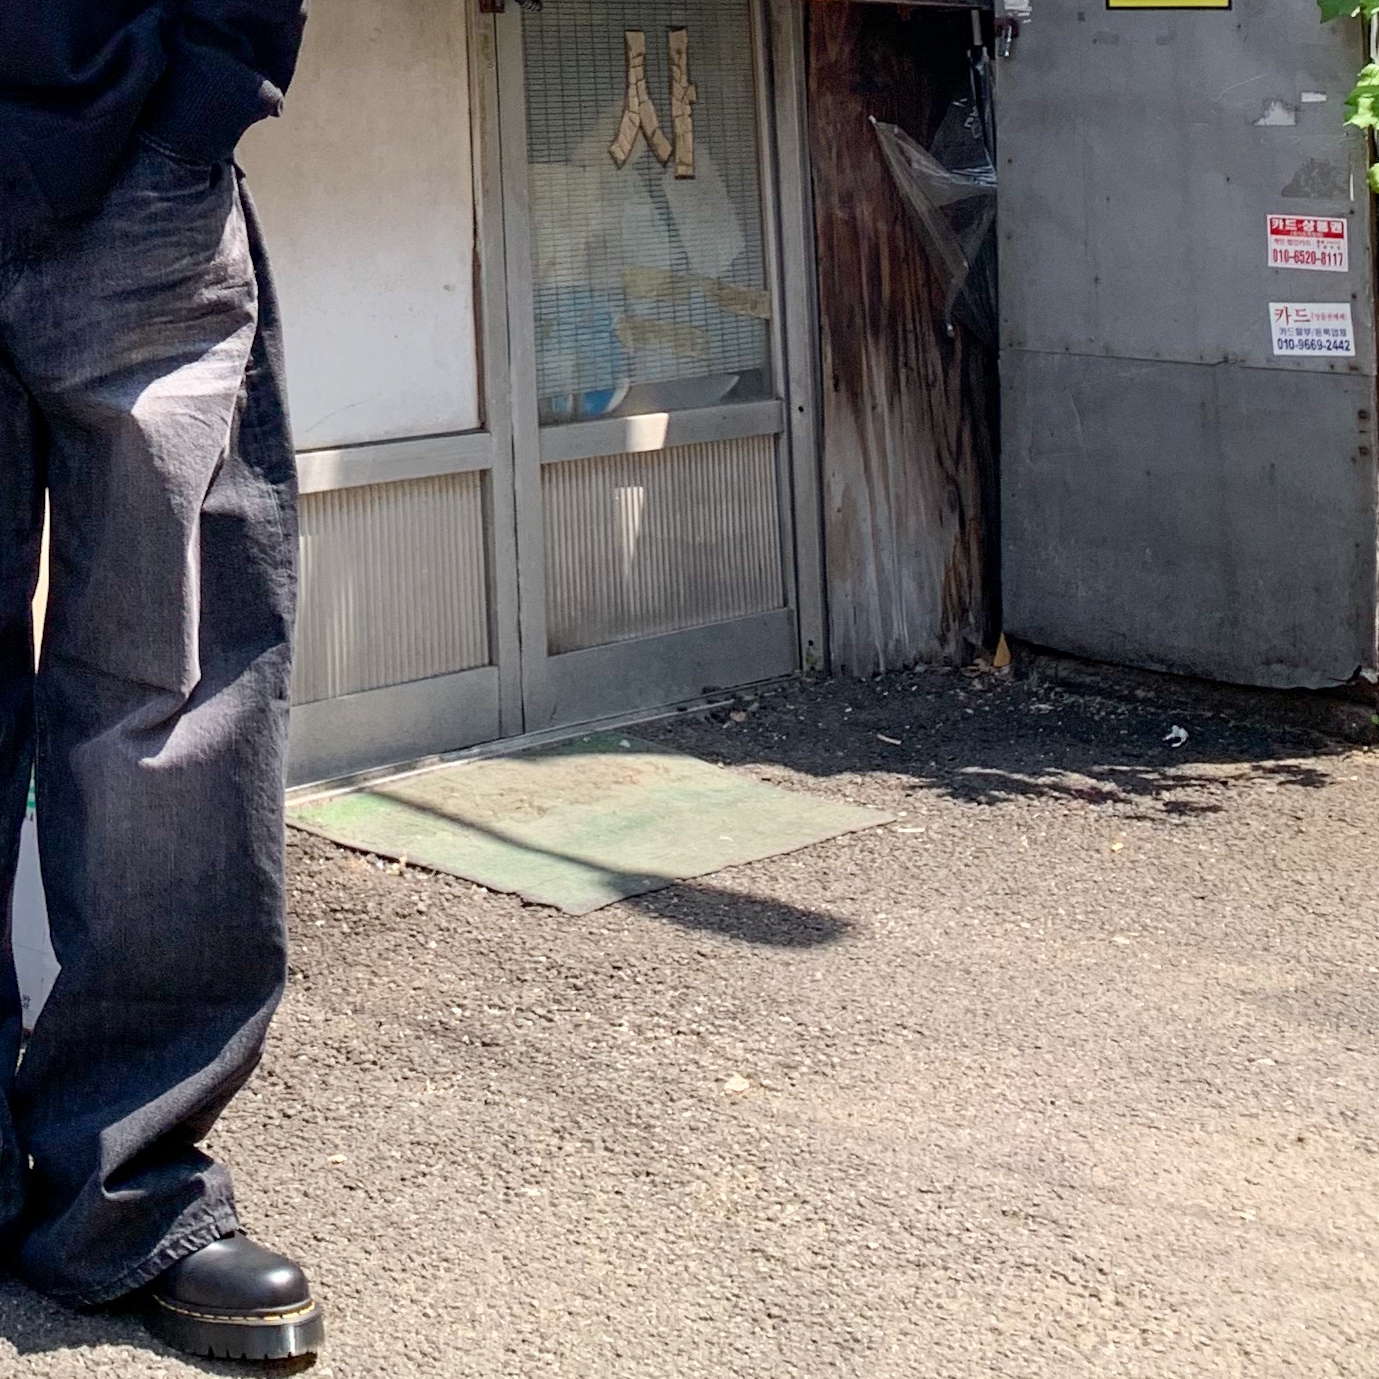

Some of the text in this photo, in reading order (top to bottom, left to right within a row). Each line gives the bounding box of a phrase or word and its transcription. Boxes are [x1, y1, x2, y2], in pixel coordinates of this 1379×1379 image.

[1272, 249, 1343, 267] 010-6520-8117
[1274, 305, 1311, 327] 카드
[1277, 338, 1351, 352] 010-9669-2442
